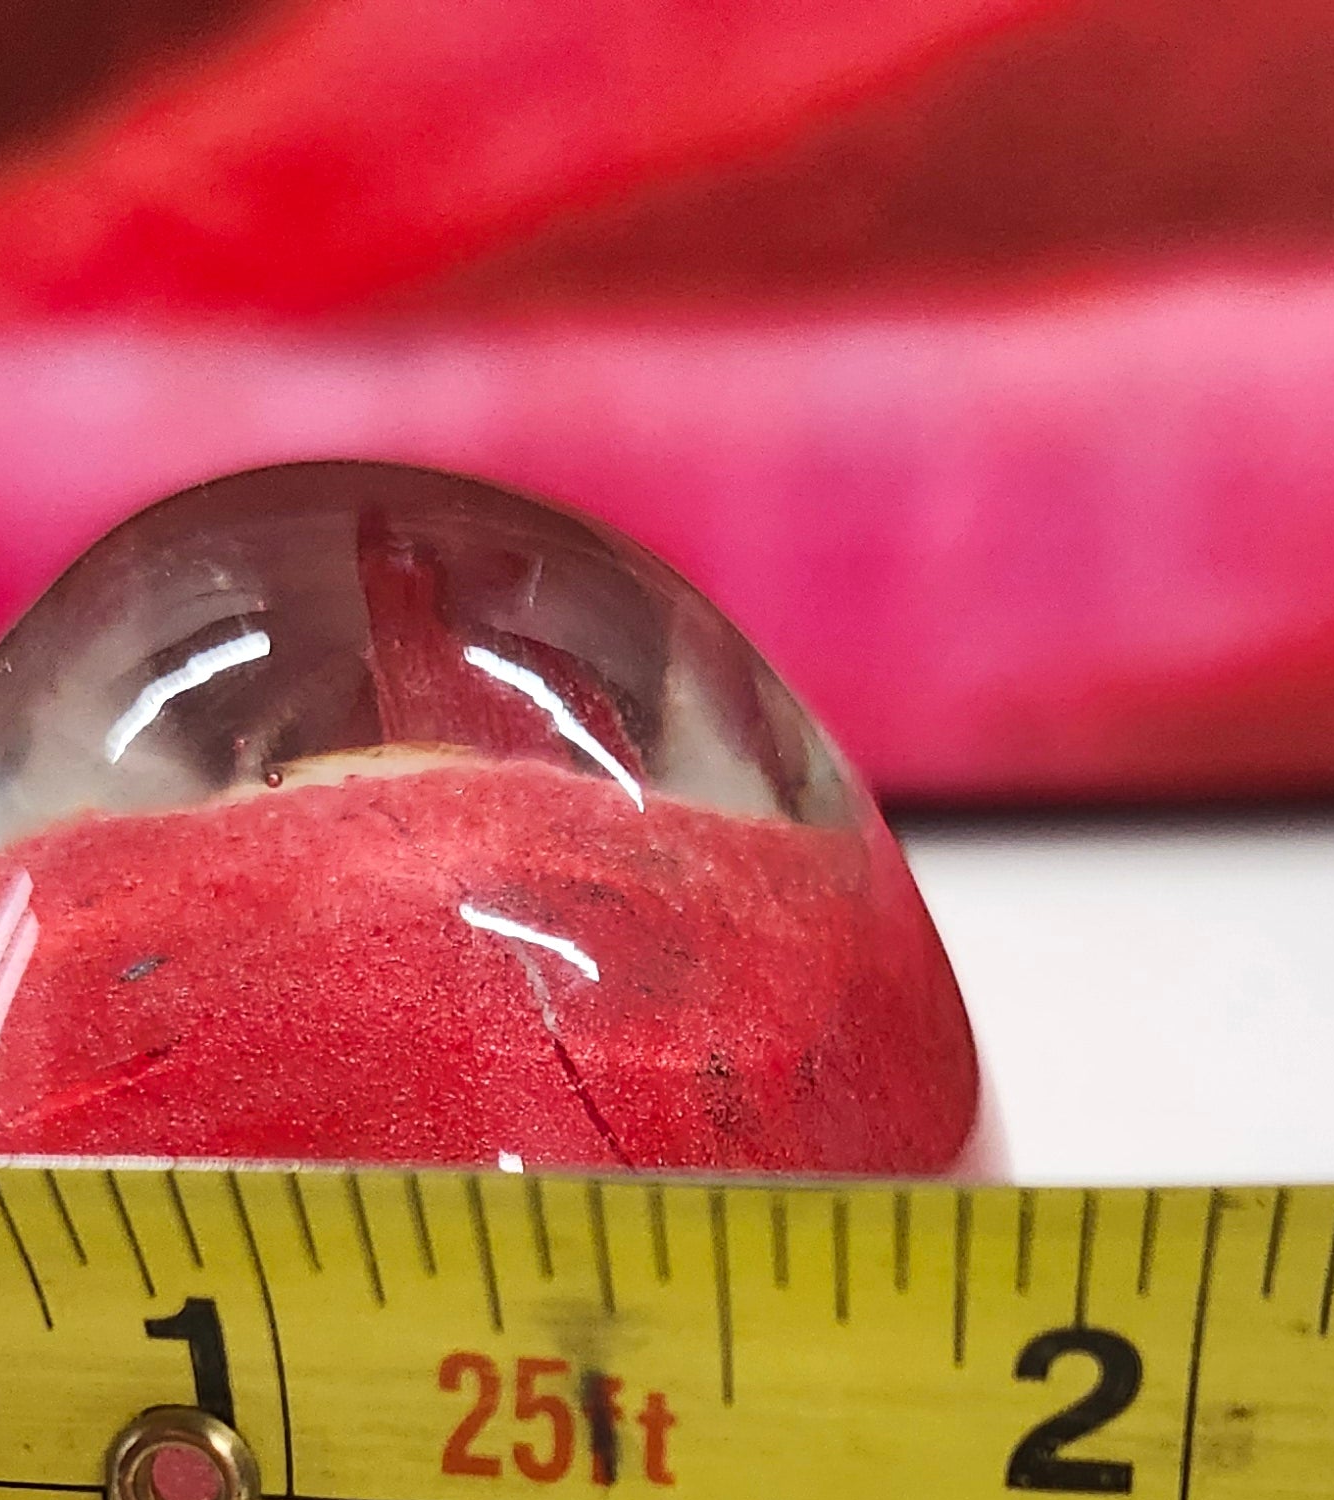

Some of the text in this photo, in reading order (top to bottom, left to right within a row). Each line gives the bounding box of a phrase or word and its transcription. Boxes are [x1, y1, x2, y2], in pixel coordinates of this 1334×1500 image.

[143, 1297, 236, 1428] 1
[437, 1350, 678, 1489] 25ft
[1005, 1326, 1144, 1495] 2
